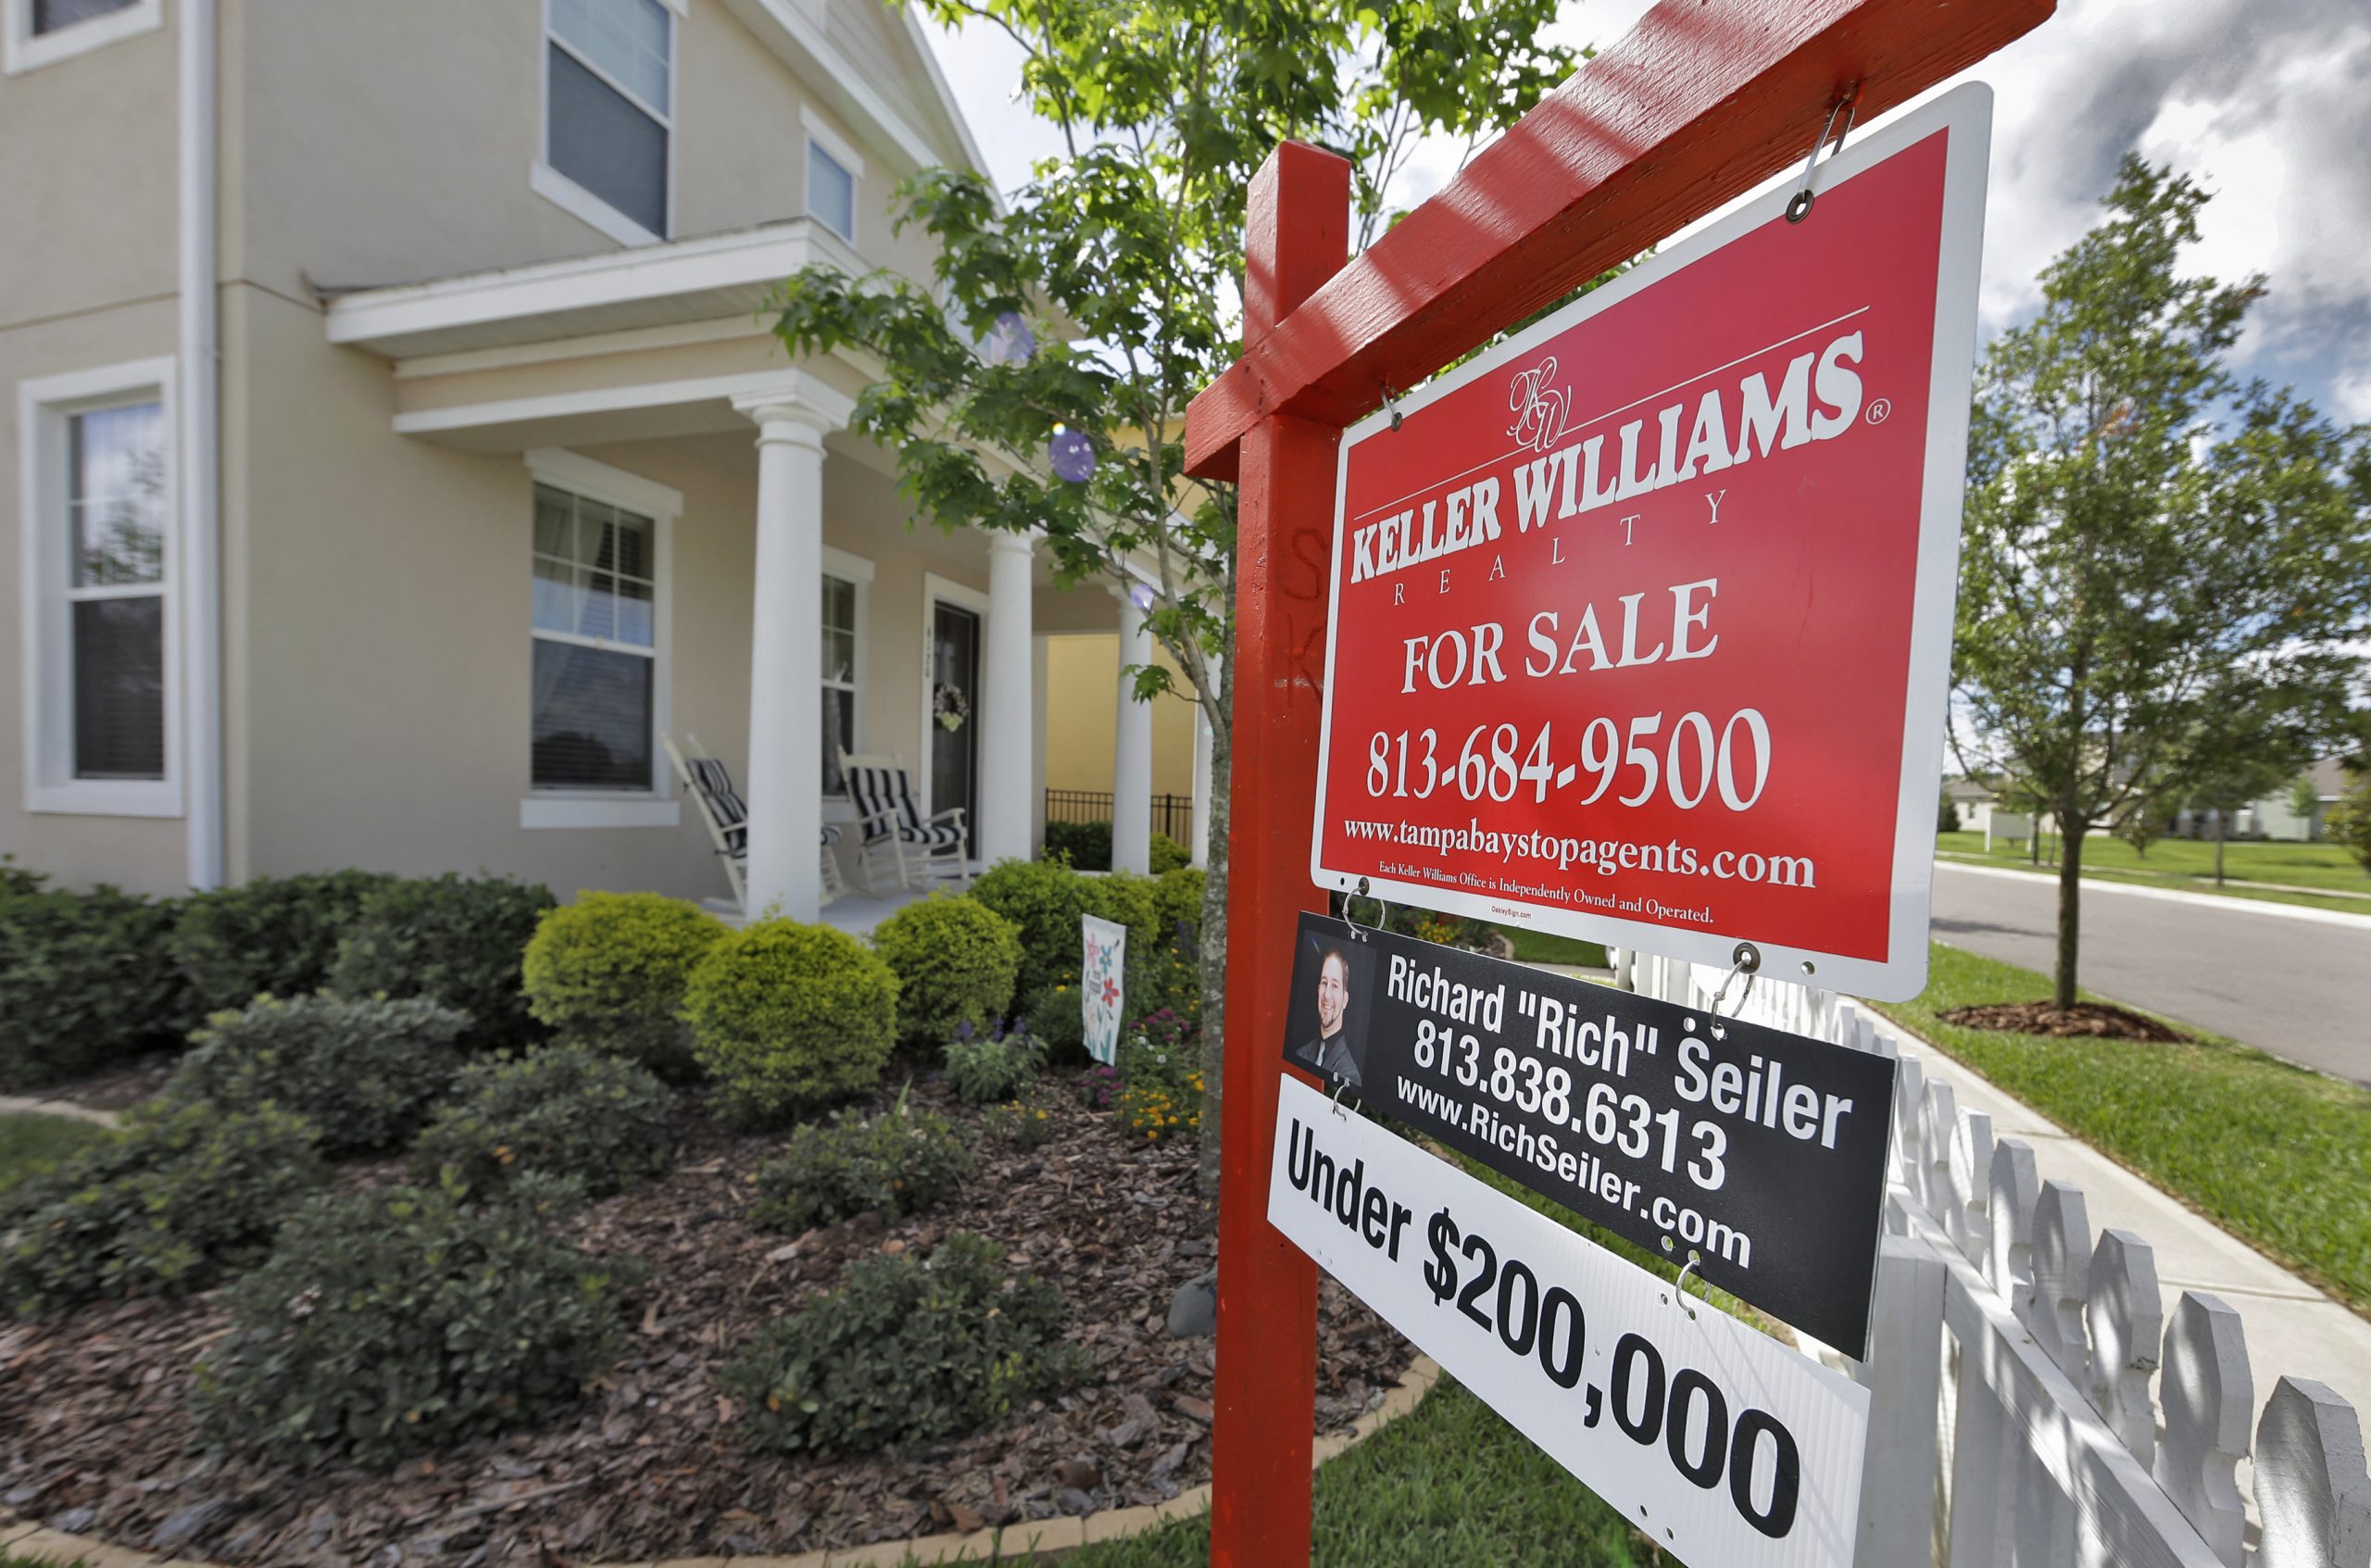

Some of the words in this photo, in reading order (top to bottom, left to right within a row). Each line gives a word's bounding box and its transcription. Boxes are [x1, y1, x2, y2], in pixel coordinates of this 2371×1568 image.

[1349, 475, 1502, 584] KELLER
[1393, 489, 1727, 607] REALTY
[1400, 622, 1508, 695] FOR
[1524, 578, 1720, 678] SALE
[1366, 708, 1771, 812] 813-684-9500
[1344, 817, 1816, 889] www.tampabaystopagents.com
[1379, 860, 1397, 874] Each
[1398, 863, 1421, 879] Keller
[1423, 866, 1458, 884] Williams
[1459, 872, 1487, 889] Office
[1488, 877, 1497, 890] is
[1499, 878, 1572, 905] Independently
[1574, 888, 1616, 909] Owned
[1618, 897, 1643, 913] and
[1645, 898, 1714, 924] Operated.
[1387, 953, 1505, 1035] Richard
[1518, 989, 1659, 1079] "Rich"
[1673, 1035, 1853, 1150] Seiler
[1413, 1018, 1729, 1192] 813.838.6313
[1396, 1074, 1752, 1271] www.RichSeiler.com
[1286, 1117, 1413, 1263] Under
[1423, 1207, 1800, 1540] $200,000
